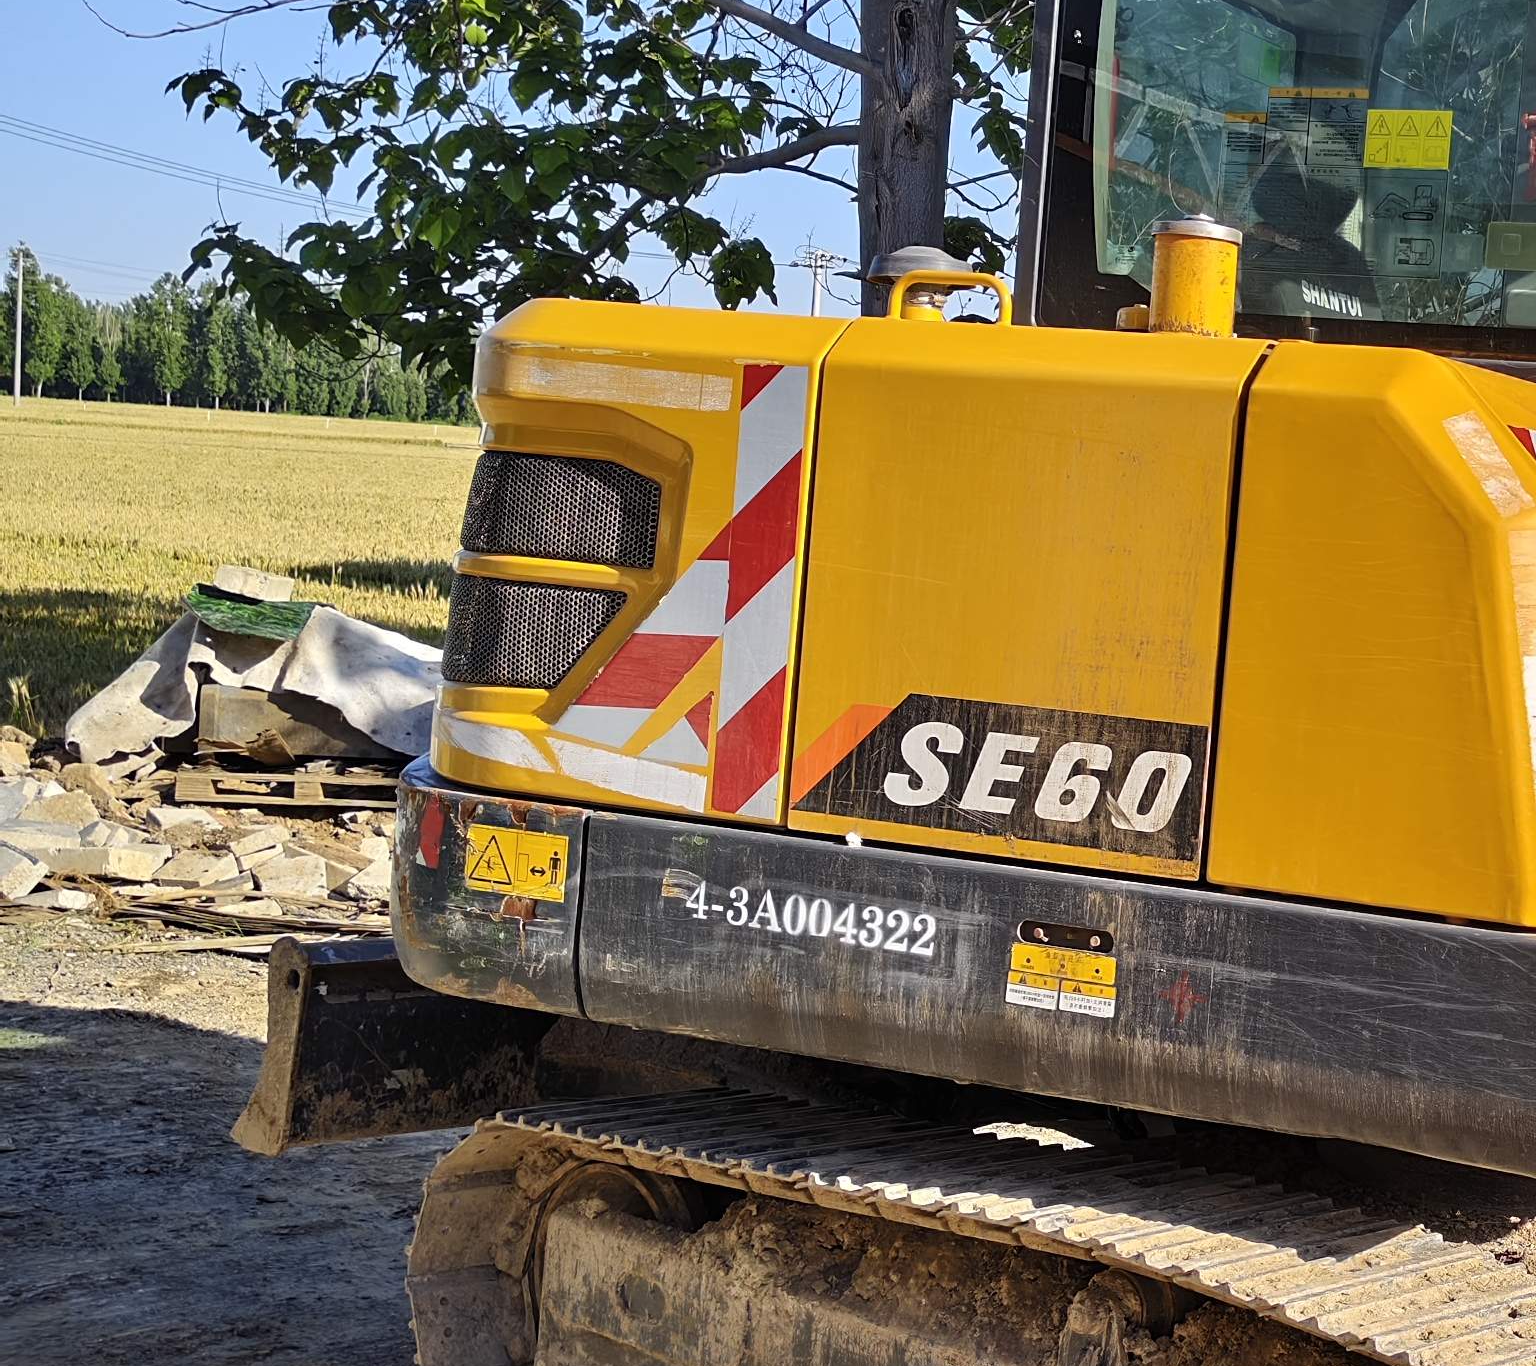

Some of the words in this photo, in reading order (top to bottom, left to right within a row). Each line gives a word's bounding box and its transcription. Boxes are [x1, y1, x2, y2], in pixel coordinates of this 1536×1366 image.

[1301, 279, 1362, 317] SHANTUI
[884, 721, 1192, 833] SE60
[686, 880, 937, 956] 4-3A004322
